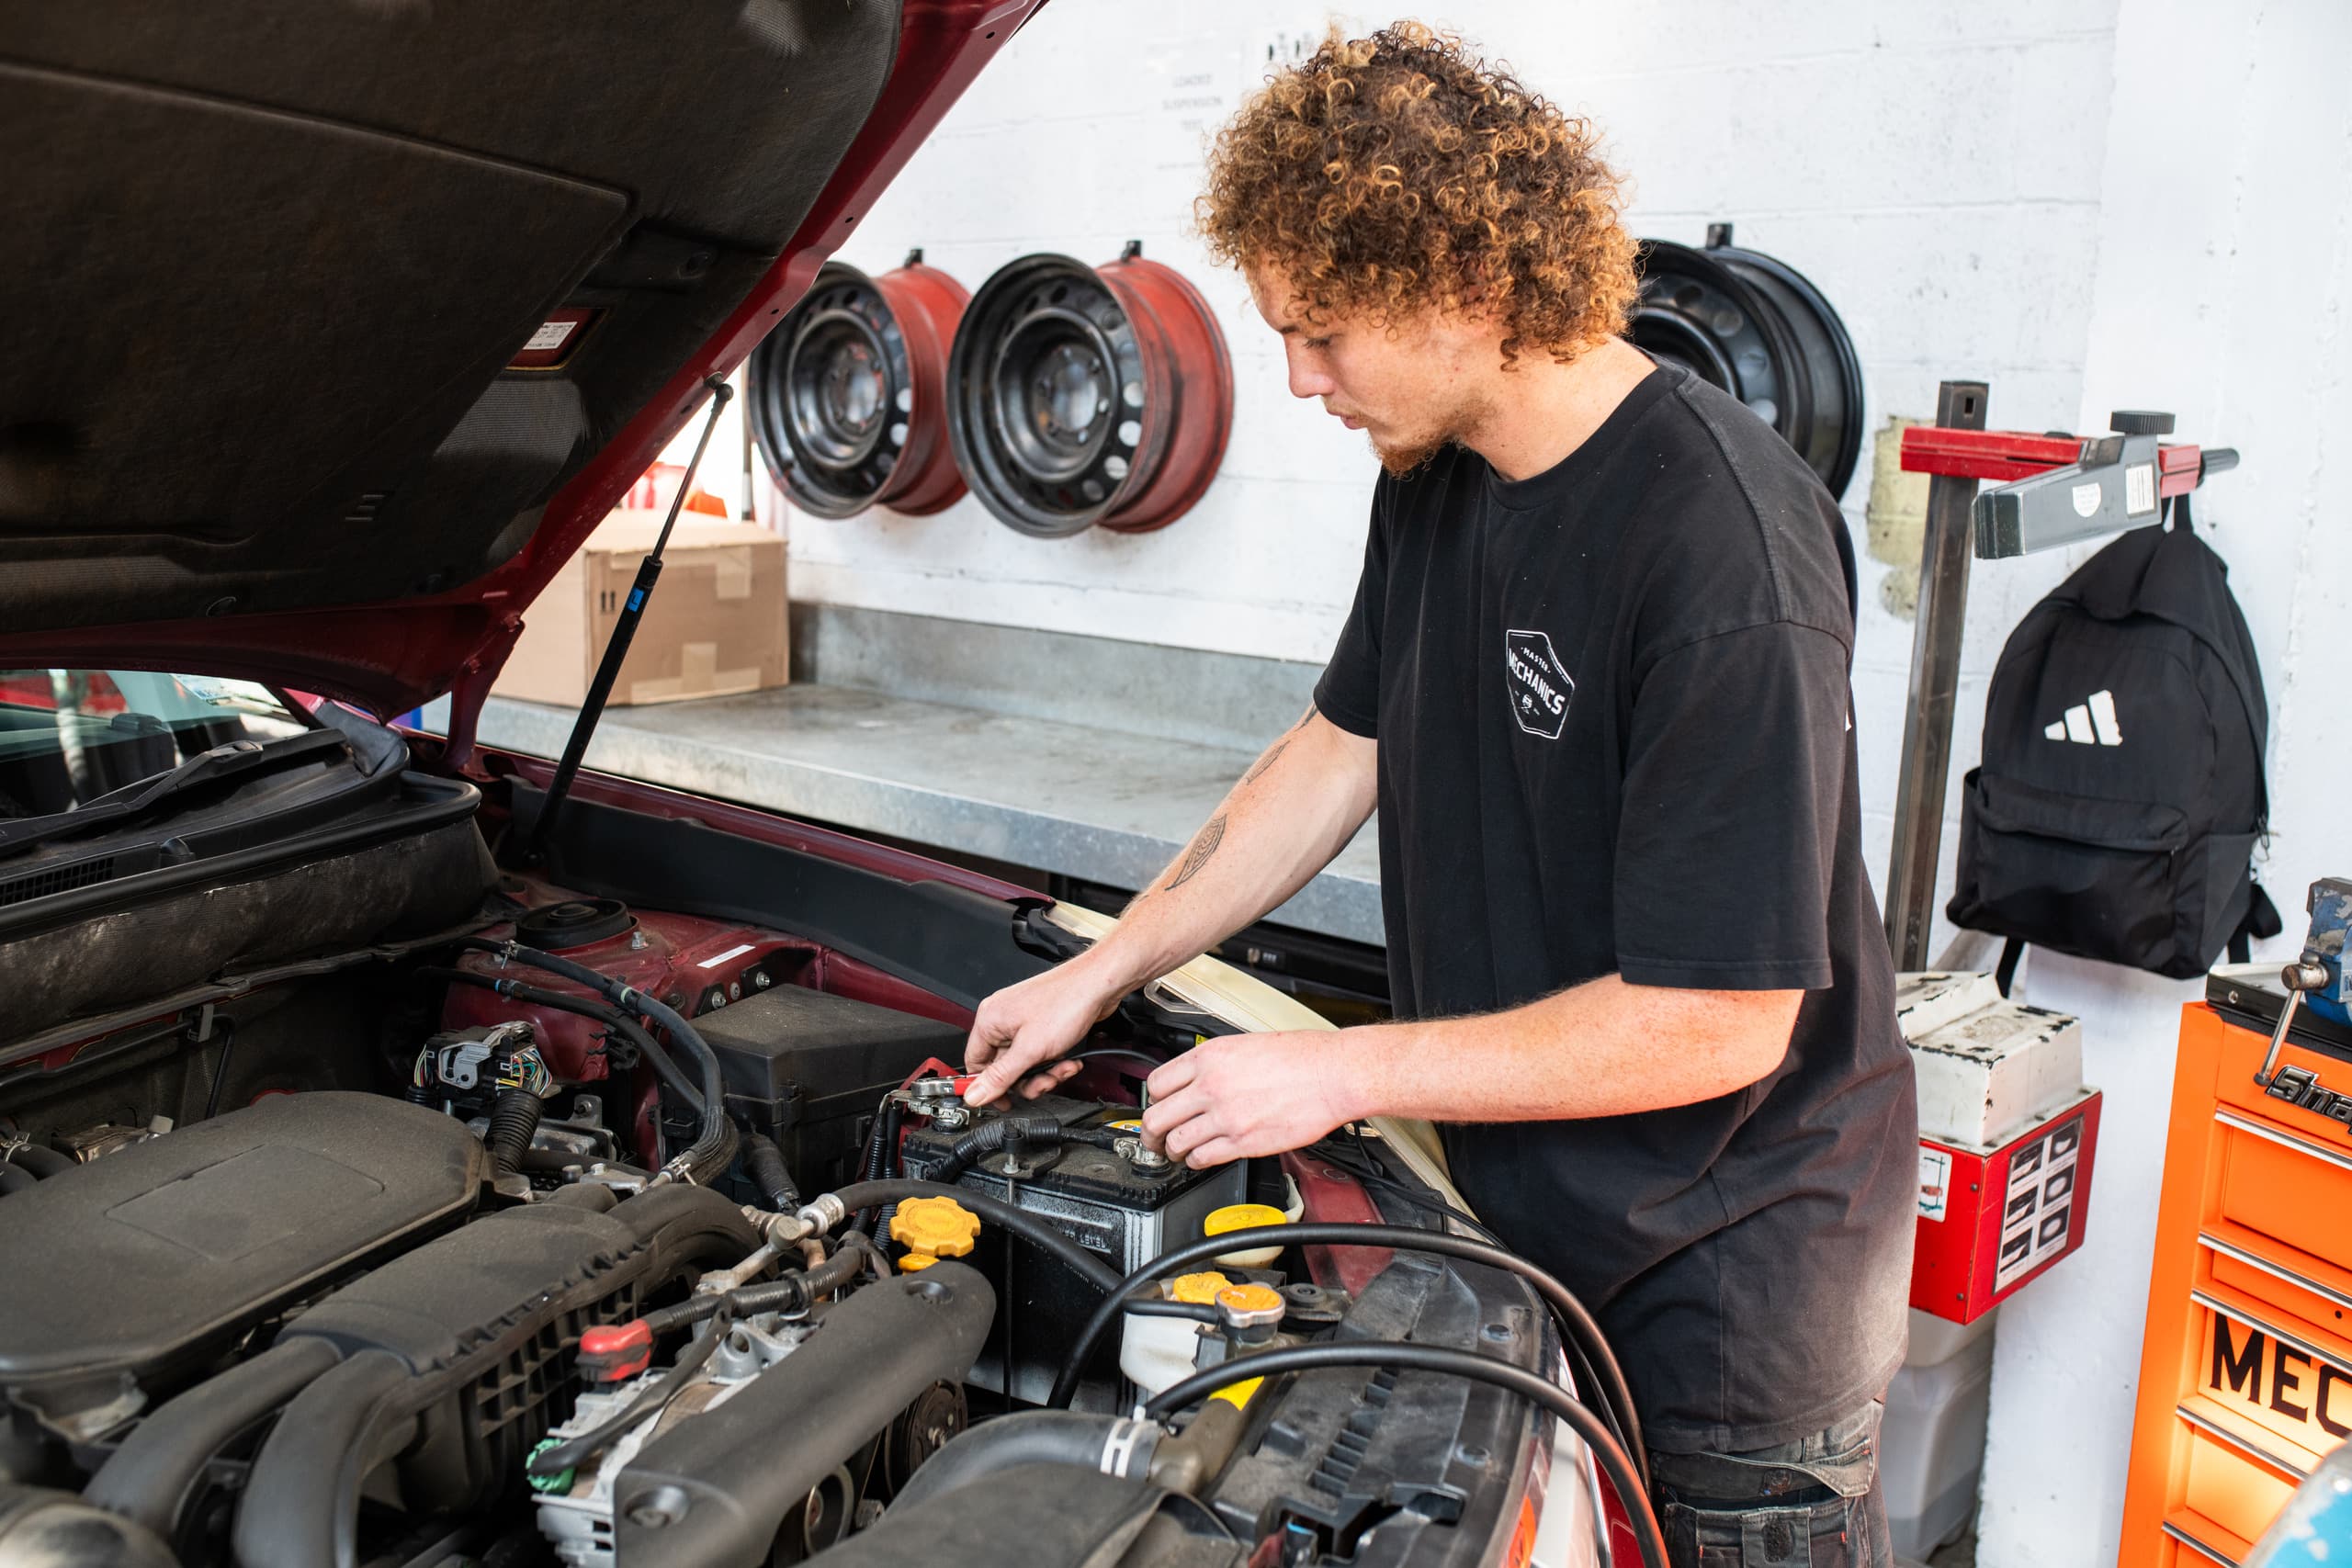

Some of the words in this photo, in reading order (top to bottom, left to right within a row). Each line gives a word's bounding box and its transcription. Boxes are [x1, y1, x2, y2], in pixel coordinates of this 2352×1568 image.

[1508, 647, 1566, 716] MECHANICS
[1522, 647, 1549, 672] MASTER
[2265, 1065, 2352, 1135] Sna
